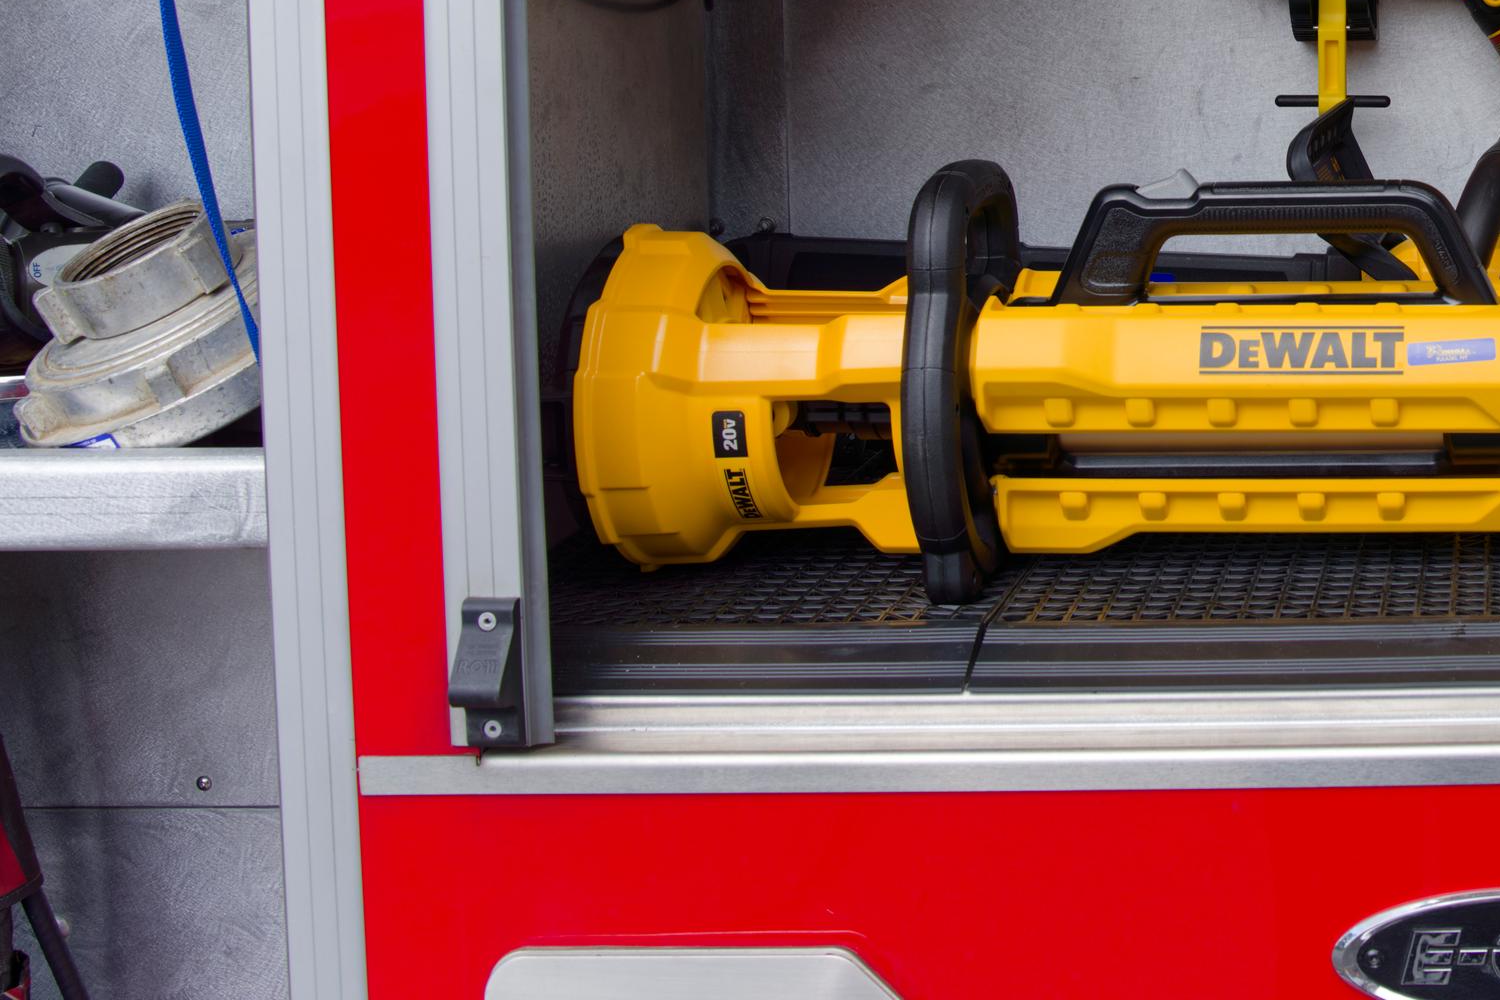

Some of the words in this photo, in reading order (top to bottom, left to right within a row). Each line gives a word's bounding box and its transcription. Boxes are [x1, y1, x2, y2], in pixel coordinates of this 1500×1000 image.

[32, 262, 42, 278] OFF
[1198, 332, 1404, 370] DEWALT
[726, 468, 761, 519] DEWALT
